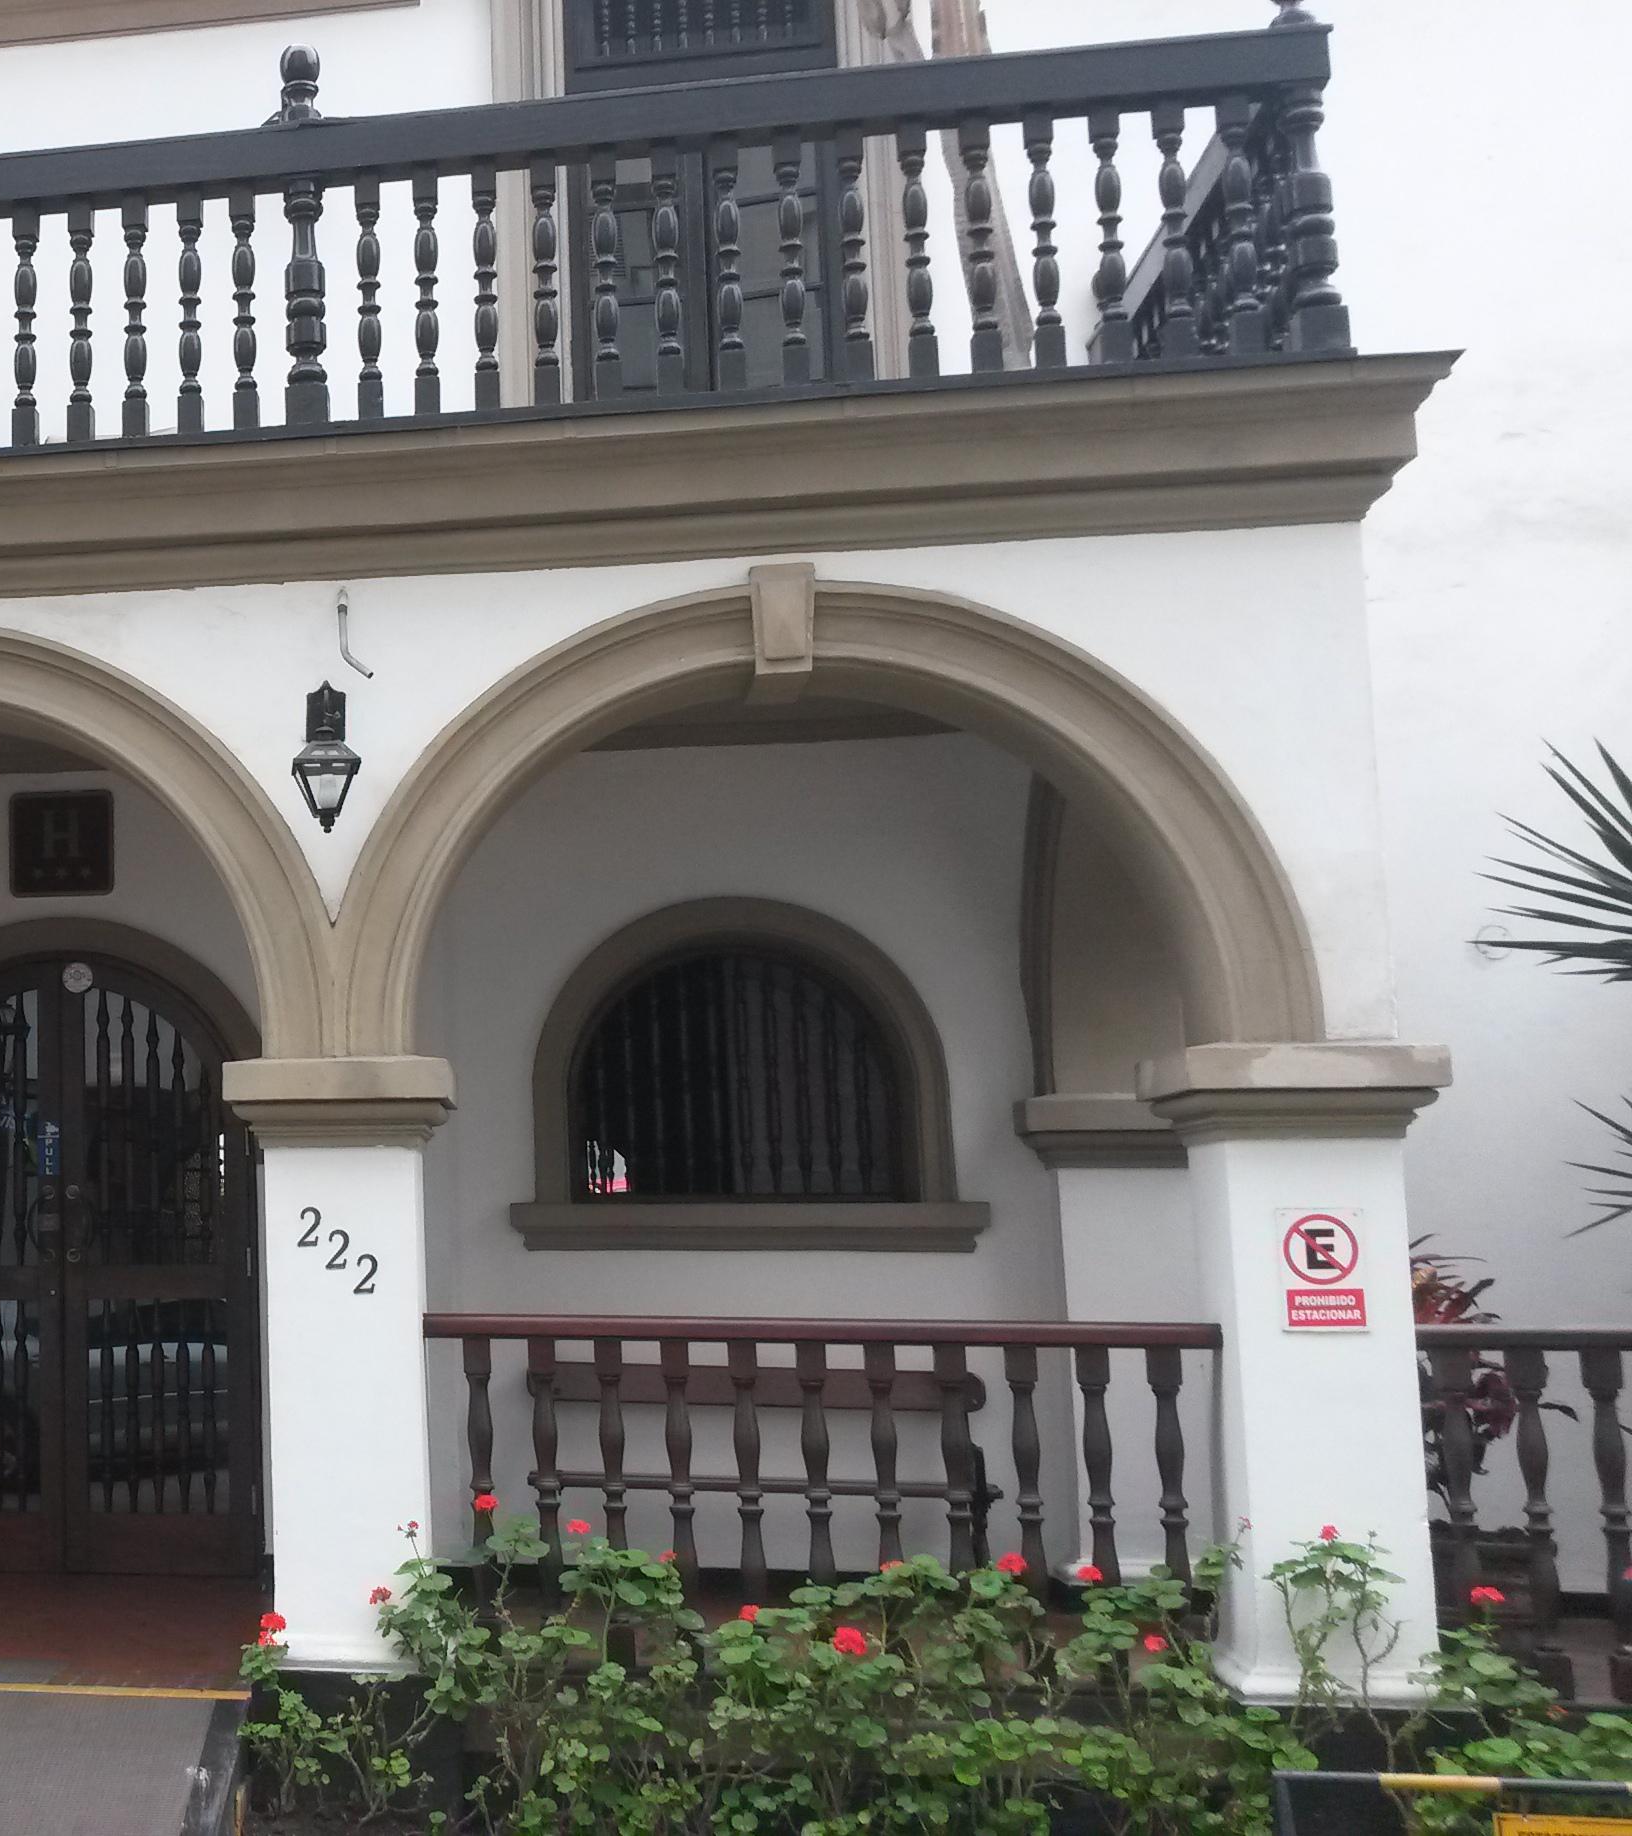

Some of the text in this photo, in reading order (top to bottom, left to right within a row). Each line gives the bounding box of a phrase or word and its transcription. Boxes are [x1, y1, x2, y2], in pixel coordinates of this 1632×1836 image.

[44, 1138, 54, 1175] PULL
[297, 1206, 378, 1295] 222
[1294, 1295, 1356, 1306] PROHIBIDO
[1291, 1309, 1362, 1321] ESTACIONAR
